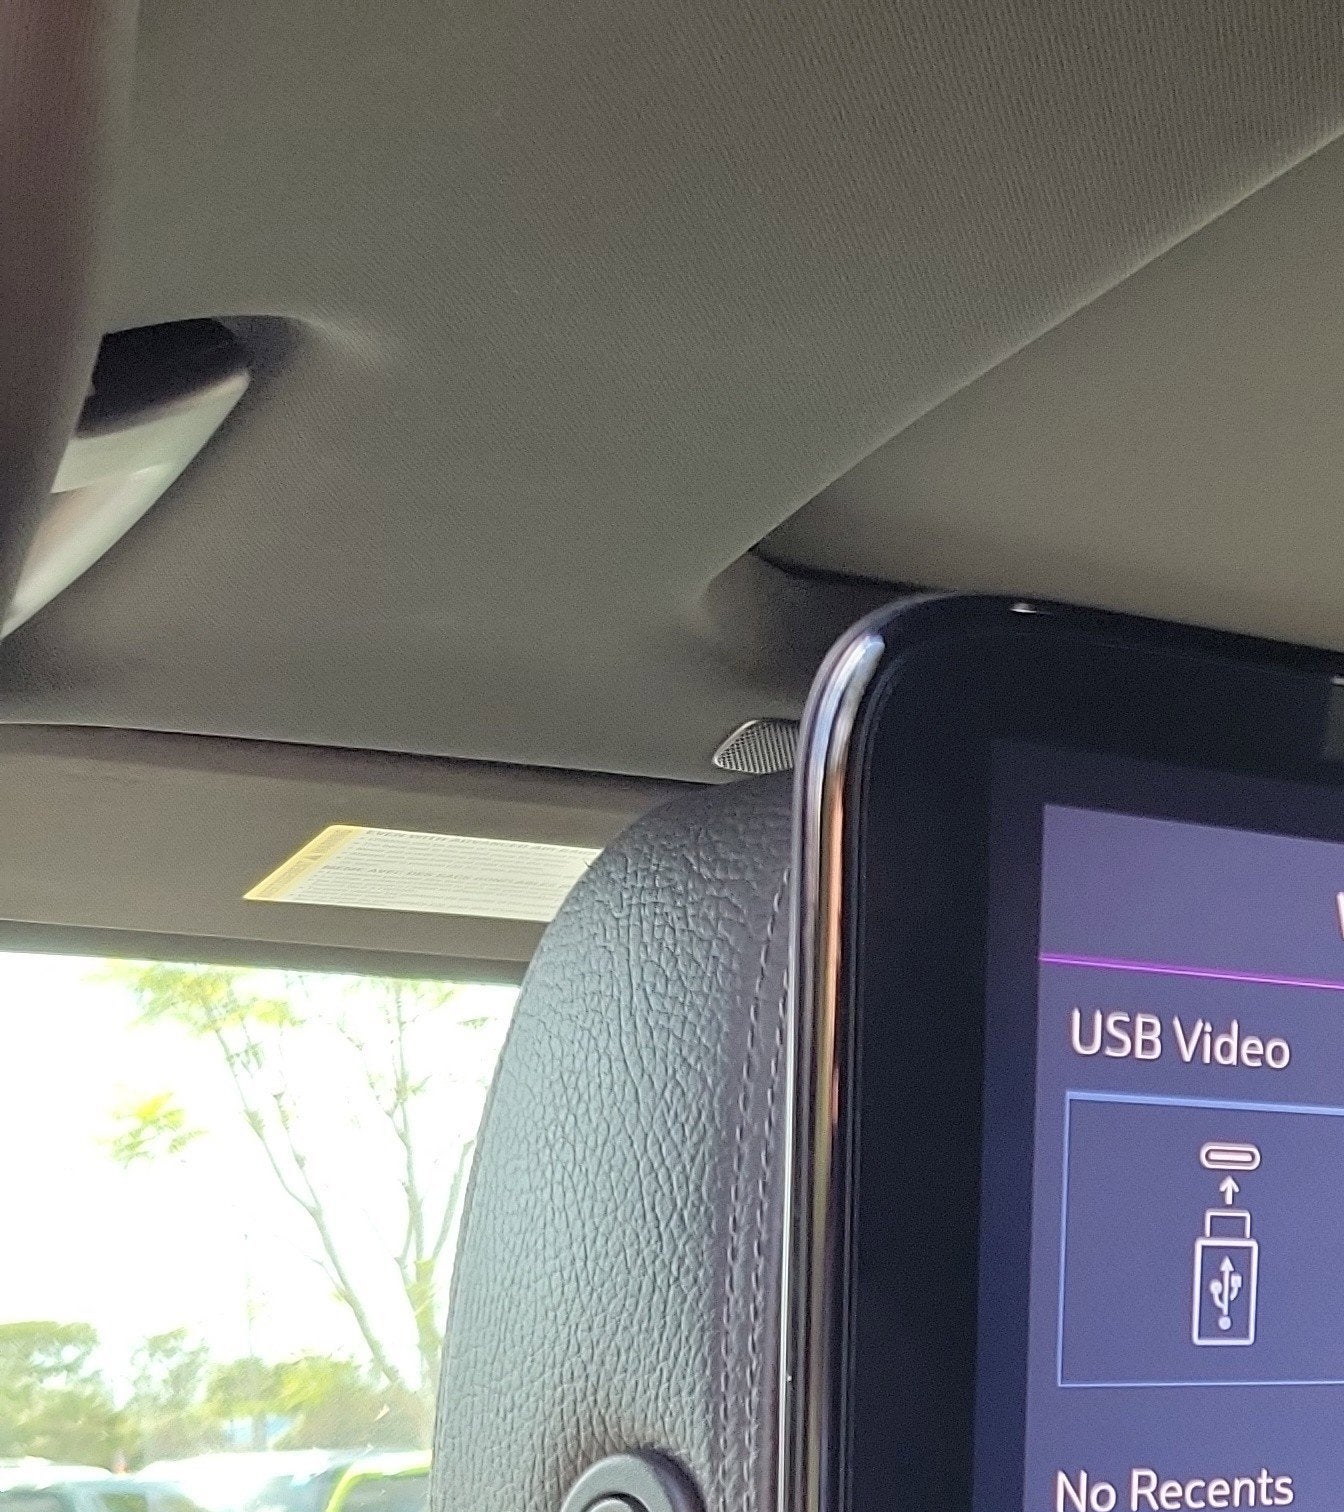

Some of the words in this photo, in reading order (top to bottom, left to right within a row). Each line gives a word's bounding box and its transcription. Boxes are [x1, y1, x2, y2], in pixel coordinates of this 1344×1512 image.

[1071, 1008, 1162, 1060] USB
[1172, 1016, 1291, 1069] Video
[1130, 1467, 1294, 1512] Recents
